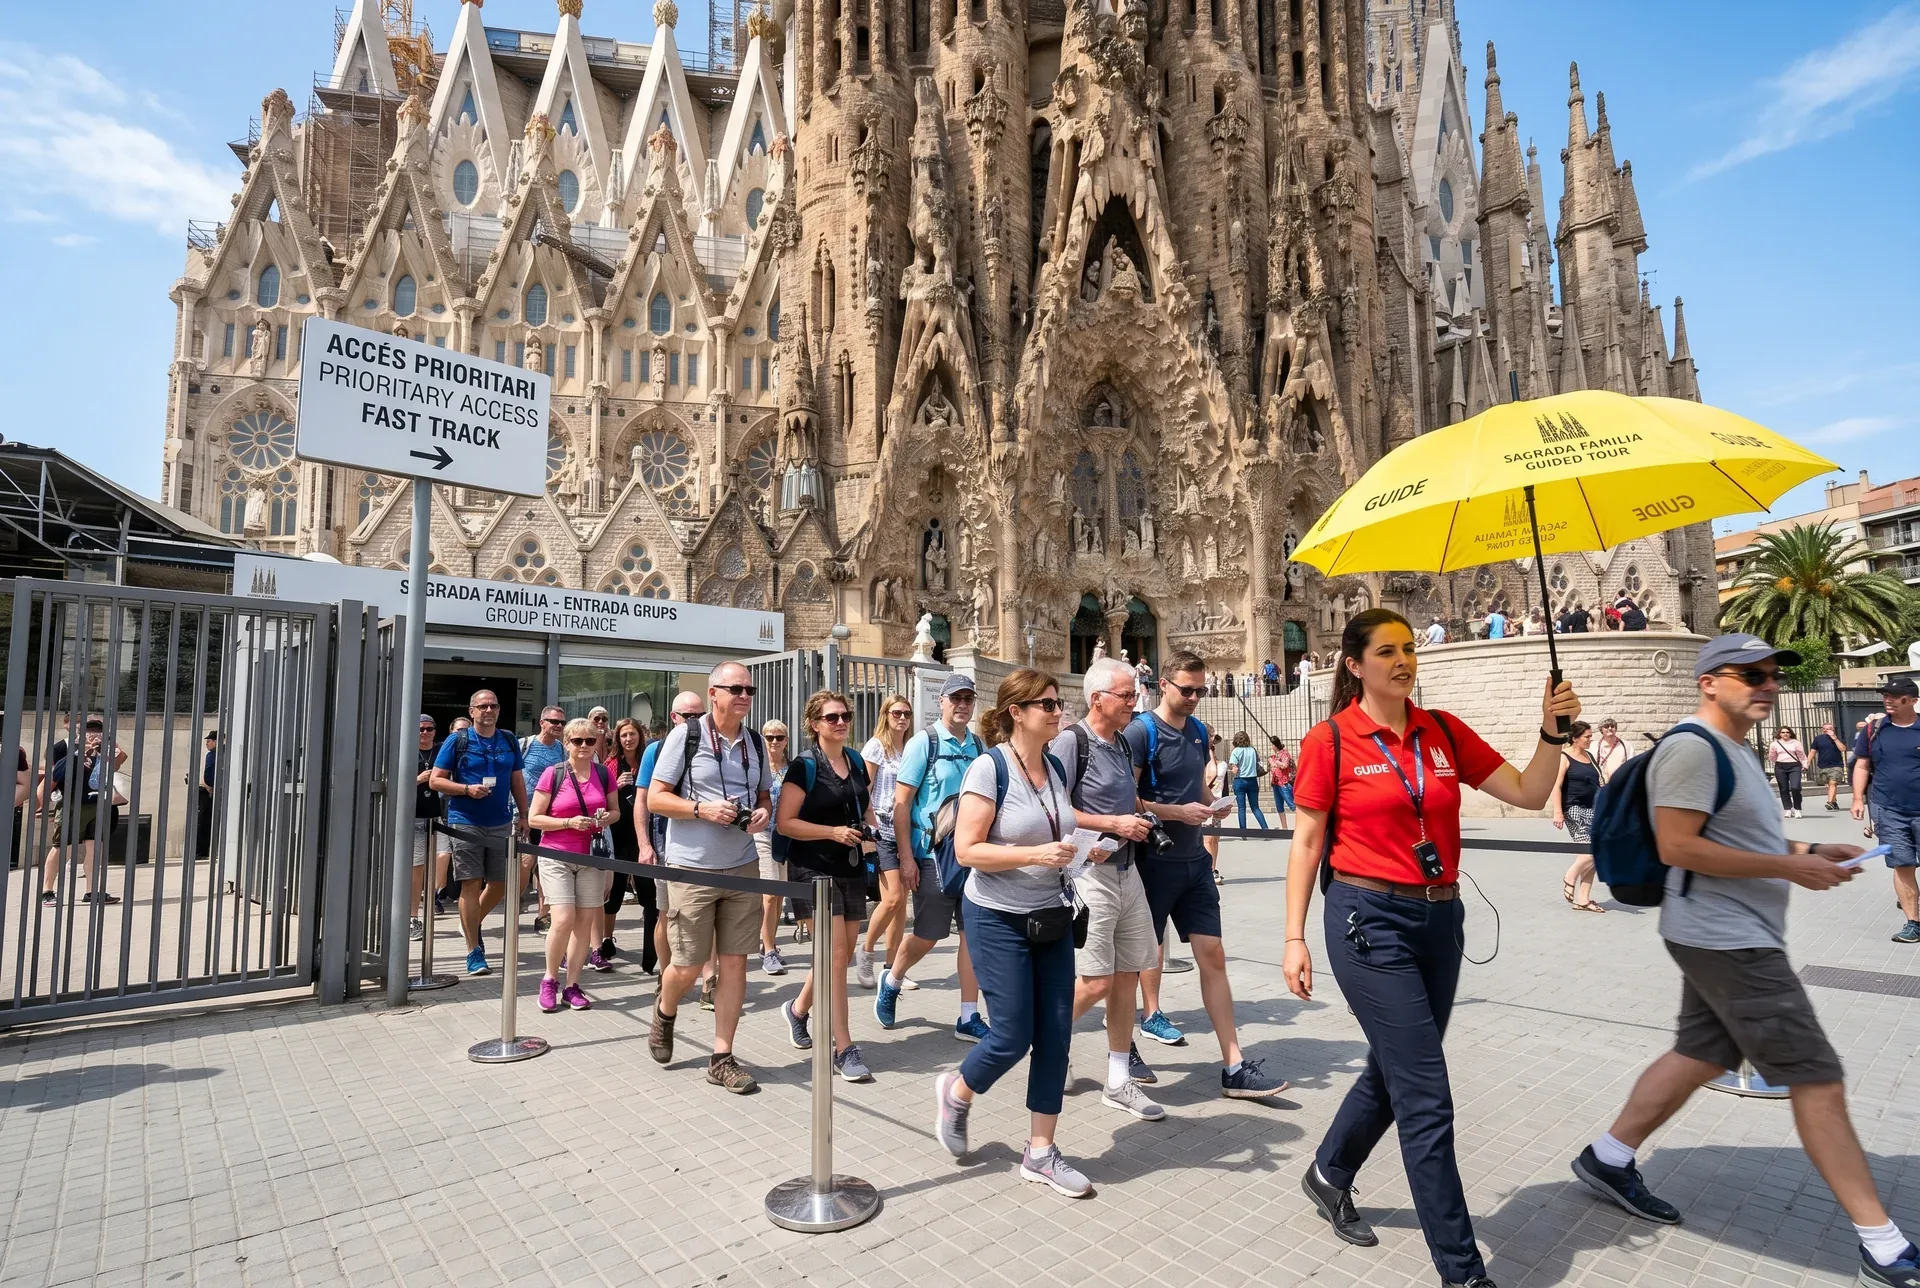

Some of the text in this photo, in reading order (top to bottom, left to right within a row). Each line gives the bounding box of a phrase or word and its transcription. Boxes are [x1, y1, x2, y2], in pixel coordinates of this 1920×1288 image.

[326, 334, 536, 400] ACCÉS PRIORITARI
[319, 361, 538, 428] PRIORITARY ACCESS
[362, 402, 501, 450] FAST TRACK
[1504, 433, 1643, 463] SAGRADA FAMILIA
[1525, 447, 1630, 470] GUIDED TOUR
[1365, 479, 1428, 511] GUIDE
[400, 580, 480, 602] SGRADA
[486, 588, 548, 608] FAMÍLIA
[564, 596, 629, 615] ENTRADA
[634, 604, 677, 620] GRUPS
[486, 607, 617, 632] GROUP ENTRANCE
[1354, 764, 1390, 776] GUIDE
